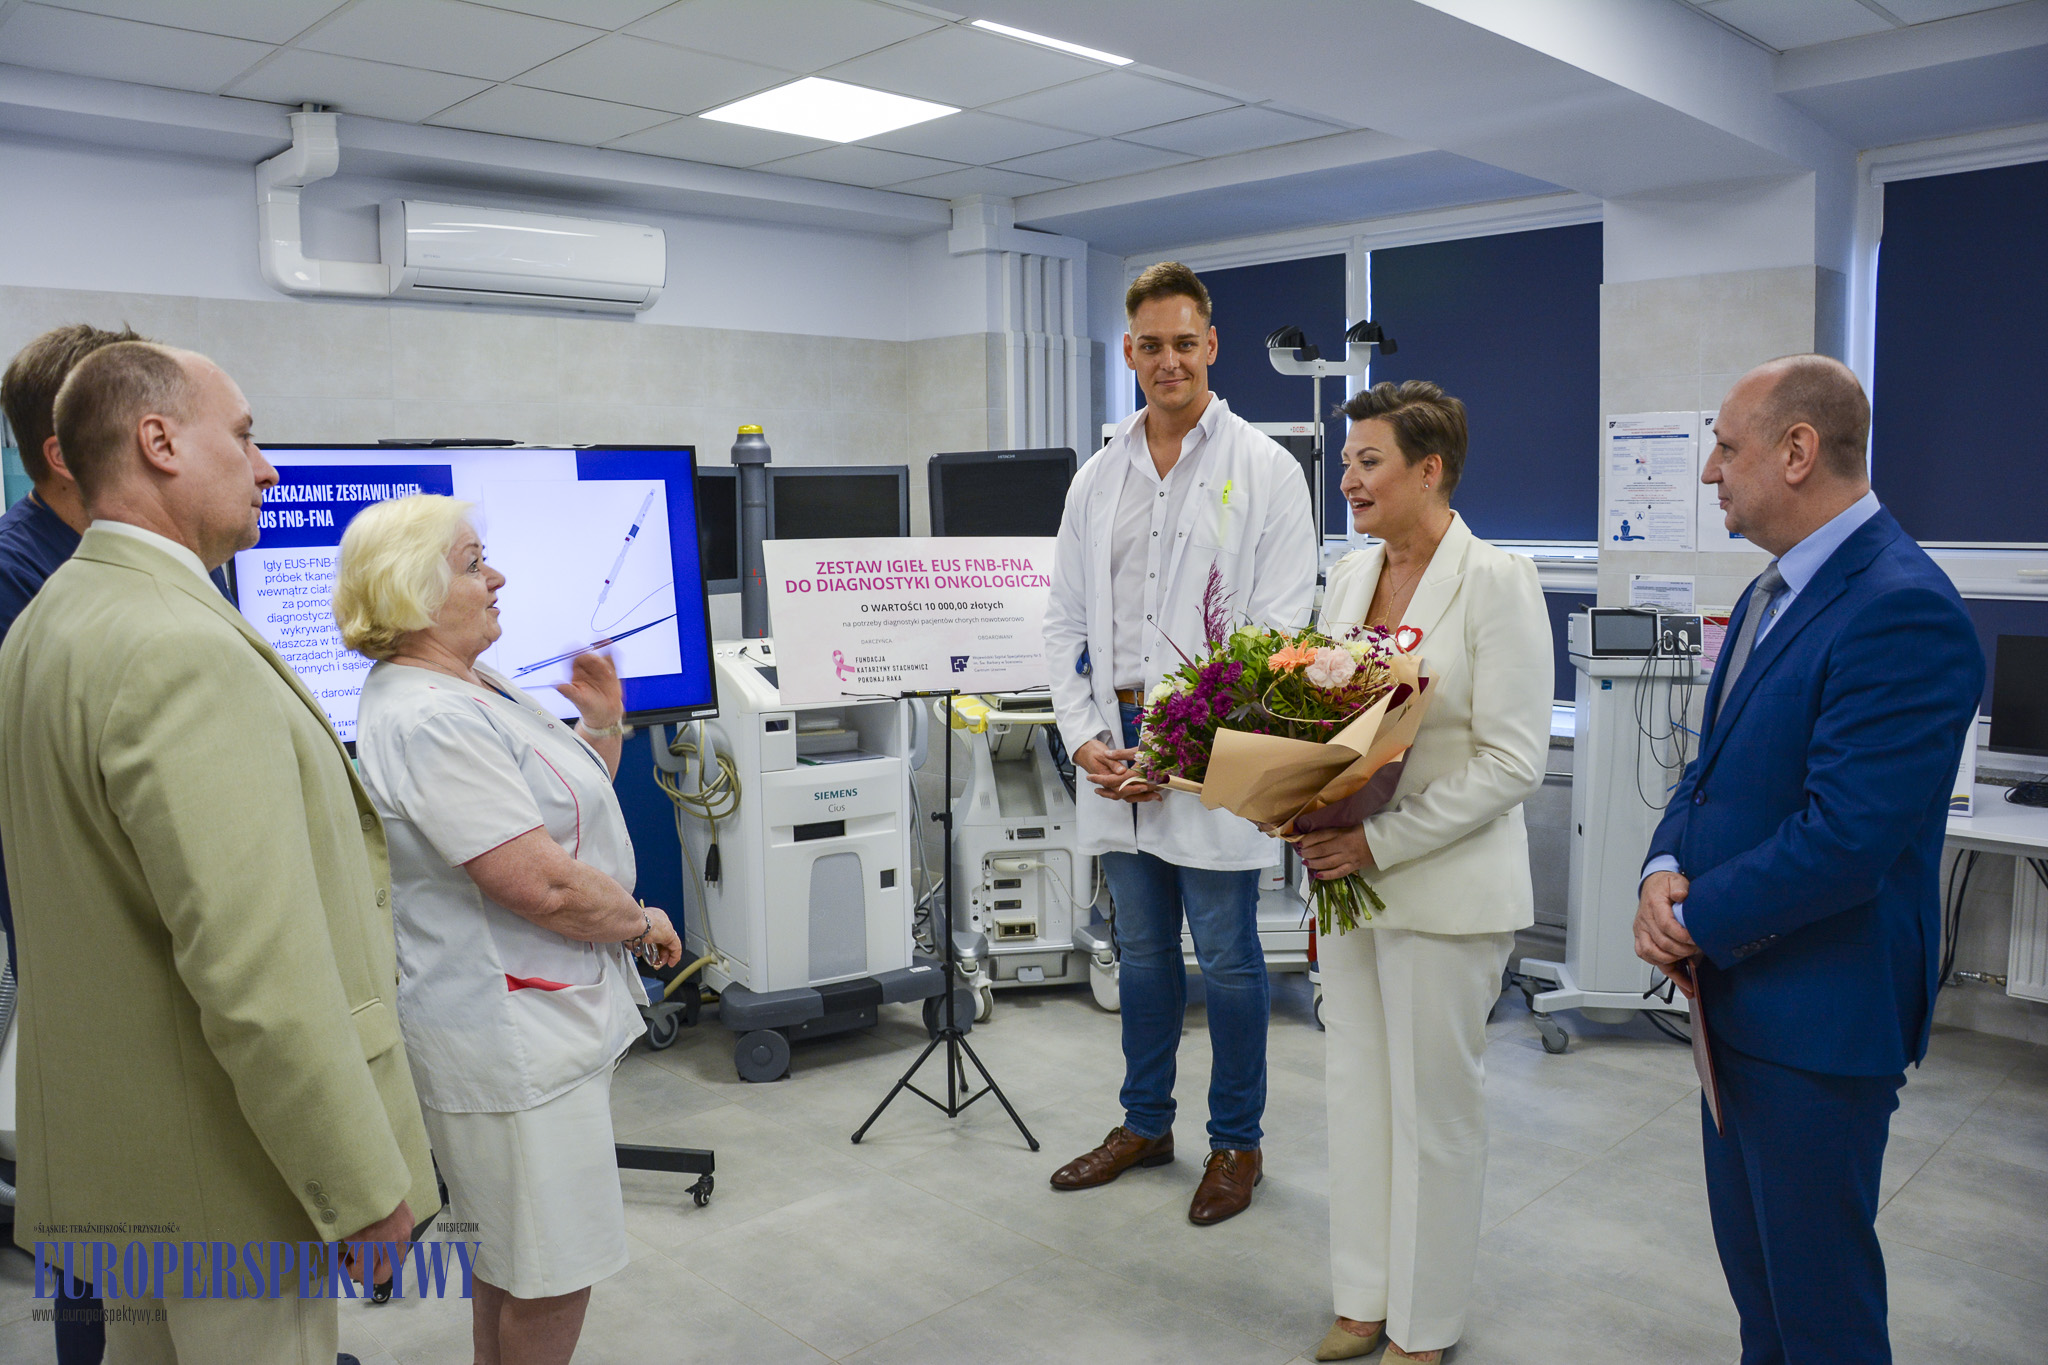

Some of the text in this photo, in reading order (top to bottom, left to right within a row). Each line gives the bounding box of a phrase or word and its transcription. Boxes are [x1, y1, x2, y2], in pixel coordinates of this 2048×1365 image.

[262, 485, 334, 503] RZEKAZANIE
[336, 484, 390, 501] ZESTAWU
[257, 509, 335, 528] US FNB-FNA
[816, 558, 1034, 575] ZESTAW IGIEŁ EUS FNB-FNA
[265, 572, 302, 585] próbek
[785, 575, 1051, 593] DO DIAGNOSTYKI ONKOLOGICZN
[257, 585, 308, 597] wewnątrz
[282, 600, 295, 609] za
[860, 601, 1004, 612] O WARTOŚCI 10 000,00 złotych
[852, 619, 882, 628] potrzeby
[883, 618, 920, 627] diagnostyki
[921, 617, 953, 626] pacjentów
[320, 638, 329, 646] w
[855, 656, 886, 664] FUNDACJA
[856, 663, 929, 673] KATARZYNY STACHOWICZ
[858, 674, 902, 683] POKONAJ RAKA
[322, 686, 361, 698] darowiz
[814, 788, 858, 801] SIEMENS
